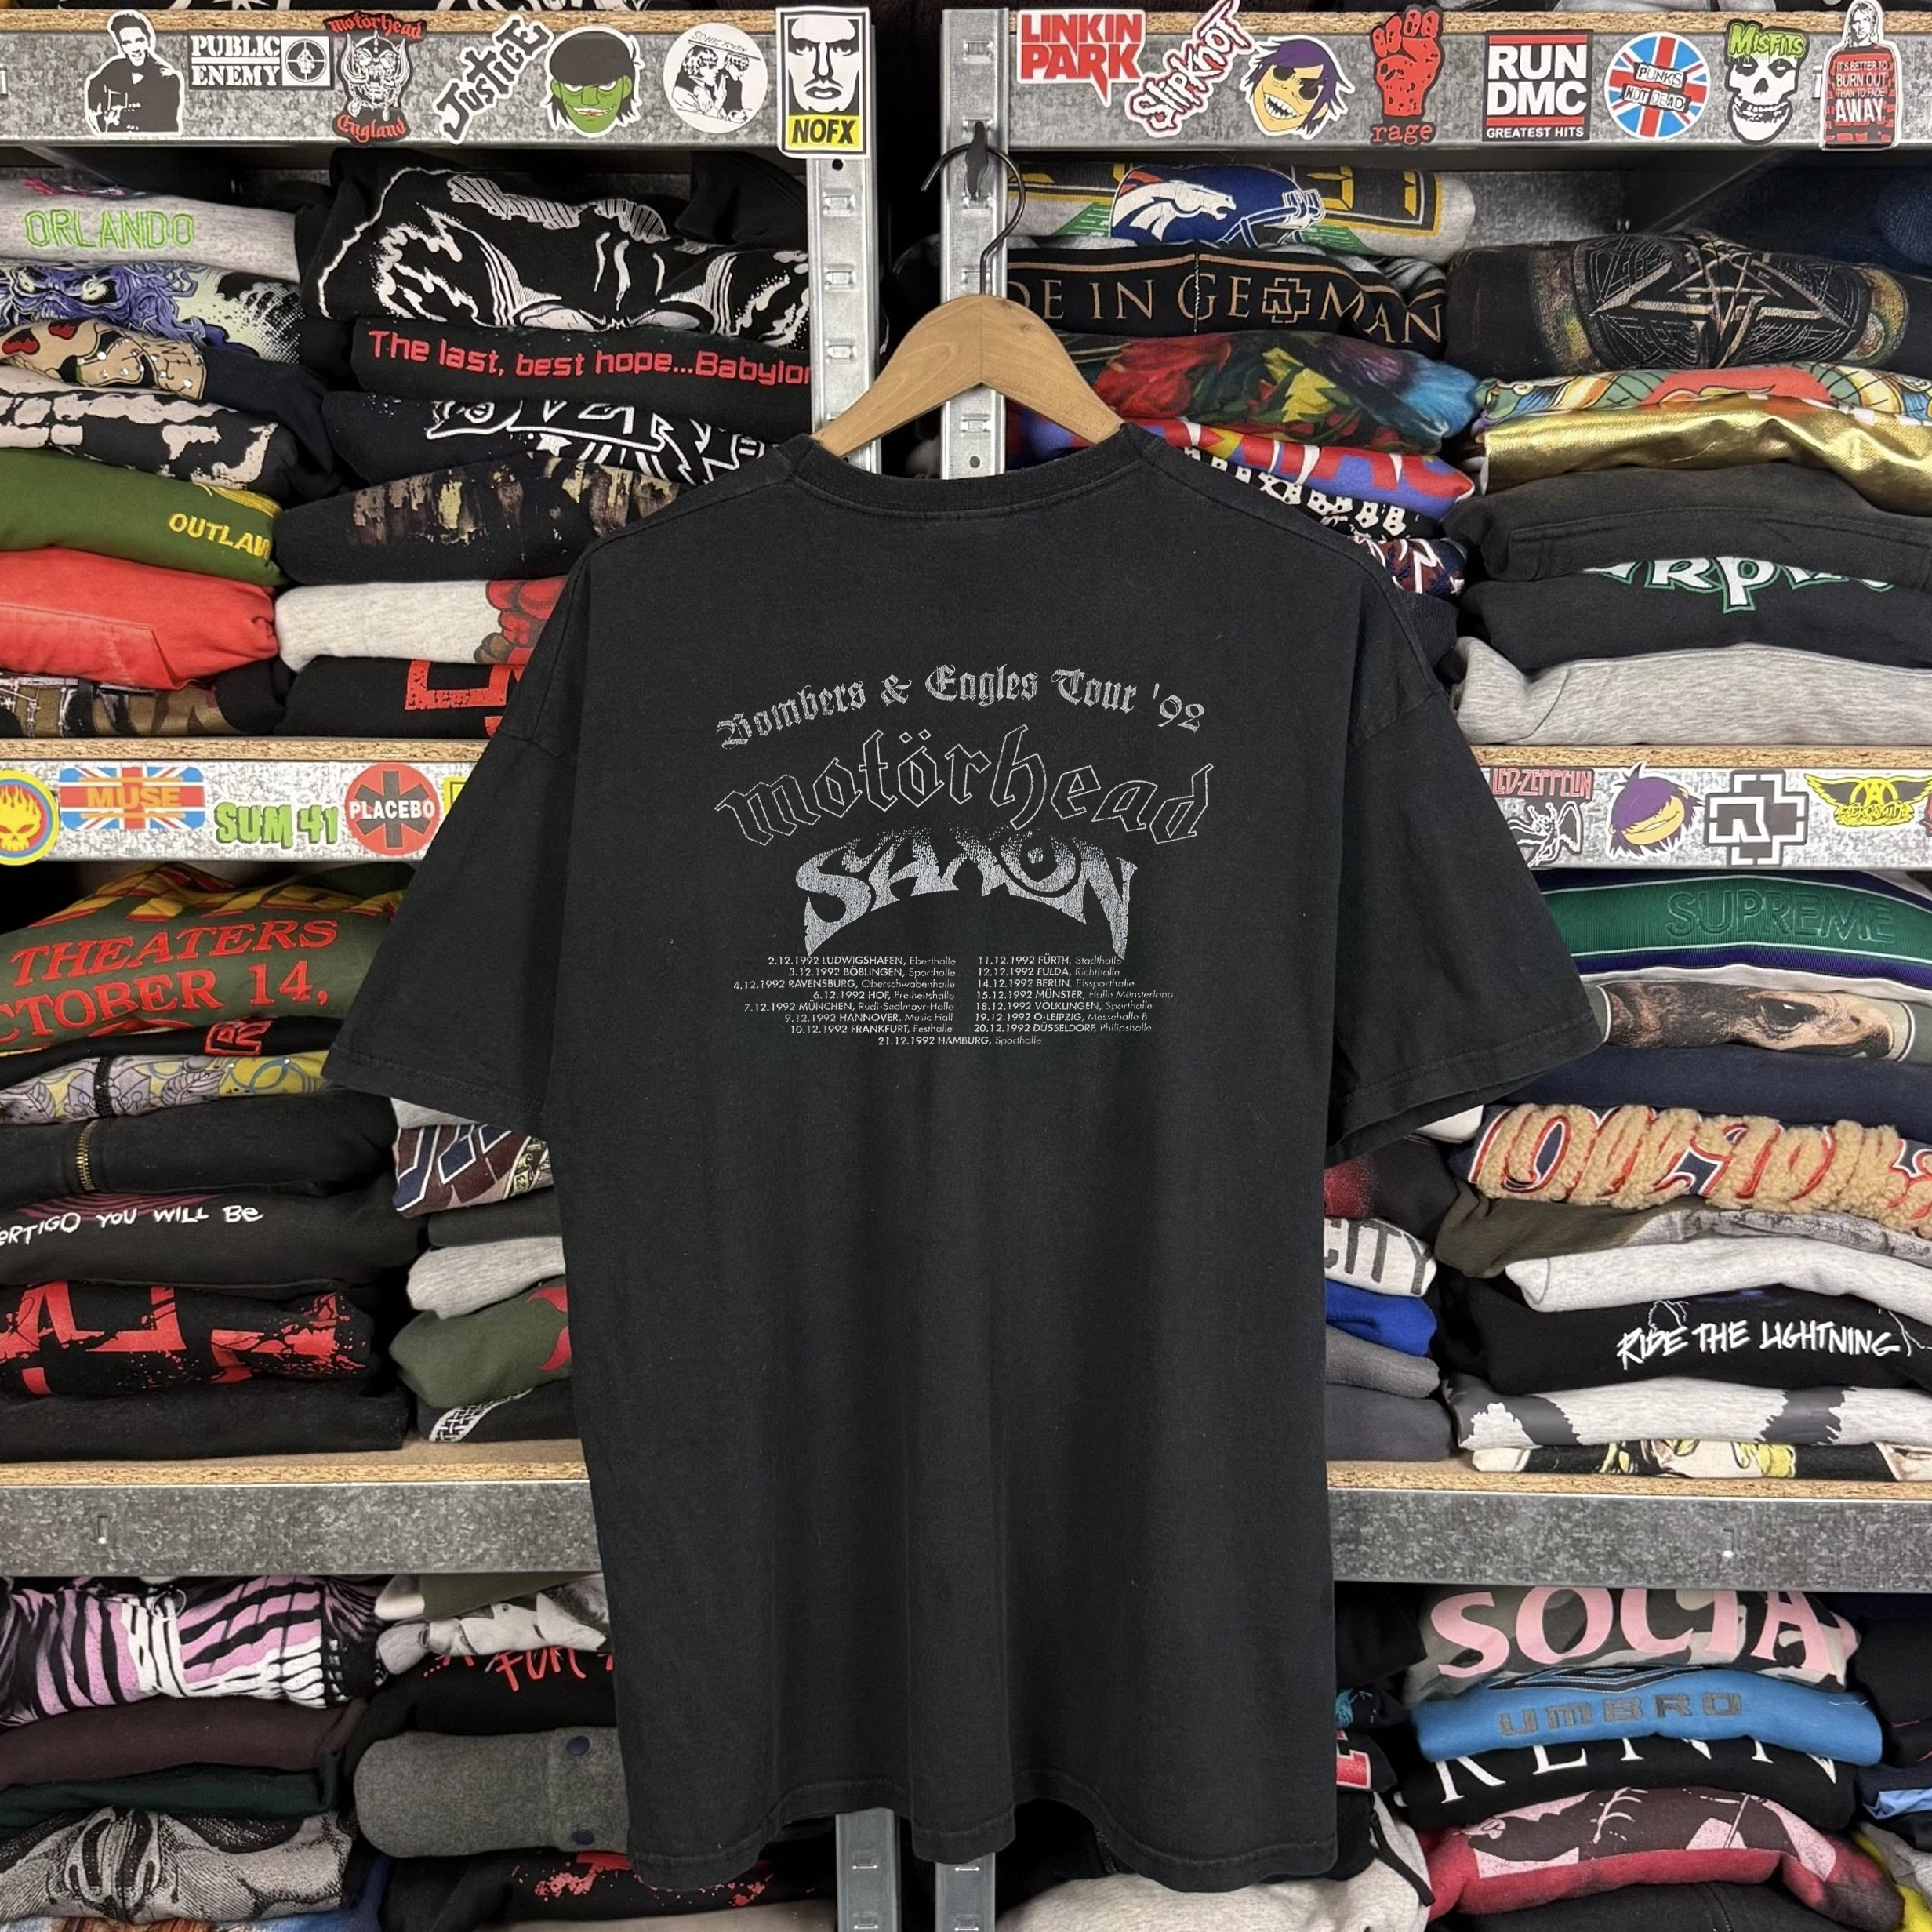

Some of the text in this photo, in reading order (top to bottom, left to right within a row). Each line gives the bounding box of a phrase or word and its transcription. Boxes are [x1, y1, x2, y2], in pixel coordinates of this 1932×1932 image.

[1022, 14, 1142, 42] LINKIN
[191, 35, 281, 57] PUBLIC
[1491, 45, 1585, 79] RUN
[1850, 60, 1877, 71] BETTER
[1878, 60, 1888, 71] TO
[191, 65, 281, 86] ENEMY
[1022, 44, 1142, 103] PARK
[1637, 66, 1683, 87] PUNKS
[1836, 73, 1865, 87] BURN
[1866, 72, 1887, 87] OUT
[1489, 82, 1587, 115] DMC
[1625, 86, 1685, 109] NOT DEAD
[1836, 87, 1885, 97] THAN TO FADE
[1836, 98, 1884, 122] AWAY
[337, 114, 406, 143] England
[792, 118, 857, 144] NOFX
[1373, 124, 1433, 143] rage
[1487, 126, 1584, 138] GREATEST HITS
[24, 209, 194, 249] ORLANDO
[1090, 279, 1155, 320] IN
[368, 330, 430, 362] The
[439, 339, 504, 377] last,
[515, 353, 585, 376] best
[717, 664, 1204, 749] Bombers & Eagles Tour '92
[86, 786, 181, 810] MUSE
[349, 801, 436, 820] PLACEBO
[214, 801, 339, 849] SUM 41
[795, 823, 1138, 961] SAXON
[1667, 890, 1894, 943] SUPREME
[10, 920, 338, 988] THEATERS
[768, 956, 956, 967] 2.12.1992 LUDWIGSHAFEN, Eberthalle
[979, 953, 1122, 965] 11.12.1992 FÜRTH, Stadthalle
[789, 965, 955, 979] 3.12.1992 BÖBLINGEN, Sporthalle
[979, 967, 1120, 977] 12.12.1992 FULDA, Richthalle
[249, 961, 329, 1006] 14,
[733, 979, 955, 990] 4.12.1992 RAVENSBURG, Oberschwabenhalle
[977, 990, 1032, 999] 15.12.1992
[1035, 988, 1085, 999] MÜNSTER,
[978, 979, 1135, 989] 14.12.1992 BERLIN, Eissporthalle
[744, 1003, 795, 1011] 7.12.1992
[799, 1000, 855, 1011] MÜNCHEN,
[813, 990, 954, 1000] 6.12.1992 HOF, Freiheitshalle
[1035, 1000, 1102, 1011] VÖLKLINGEN,
[1106, 1002, 1152, 1011] Sporthalle
[840, 1013, 901, 1022] HANNOVER,
[905, 1013, 931, 1022] Music
[974, 1024, 1030, 1033] 20.12.1992
[1033, 1021, 1097, 1033] DÜSSELDORF,
[1034, 1013, 1084, 1022] O-LEIPZIG,
[791, 1024, 953, 1033] 10.12.1992 FRANKFURT, Festhalle
[878, 1036, 1041, 1046] 21.12.1992 HAMBURG, Sporthalle
[96, 1208, 137, 1228] YOU
[154, 1206, 209, 1223] WILL
[1617, 1320, 1901, 1370] RIDE THE LIGHTNING
[1430, 1586, 1858, 1678] SOCIA
[1499, 1692, 1741, 1737] UMBRO
